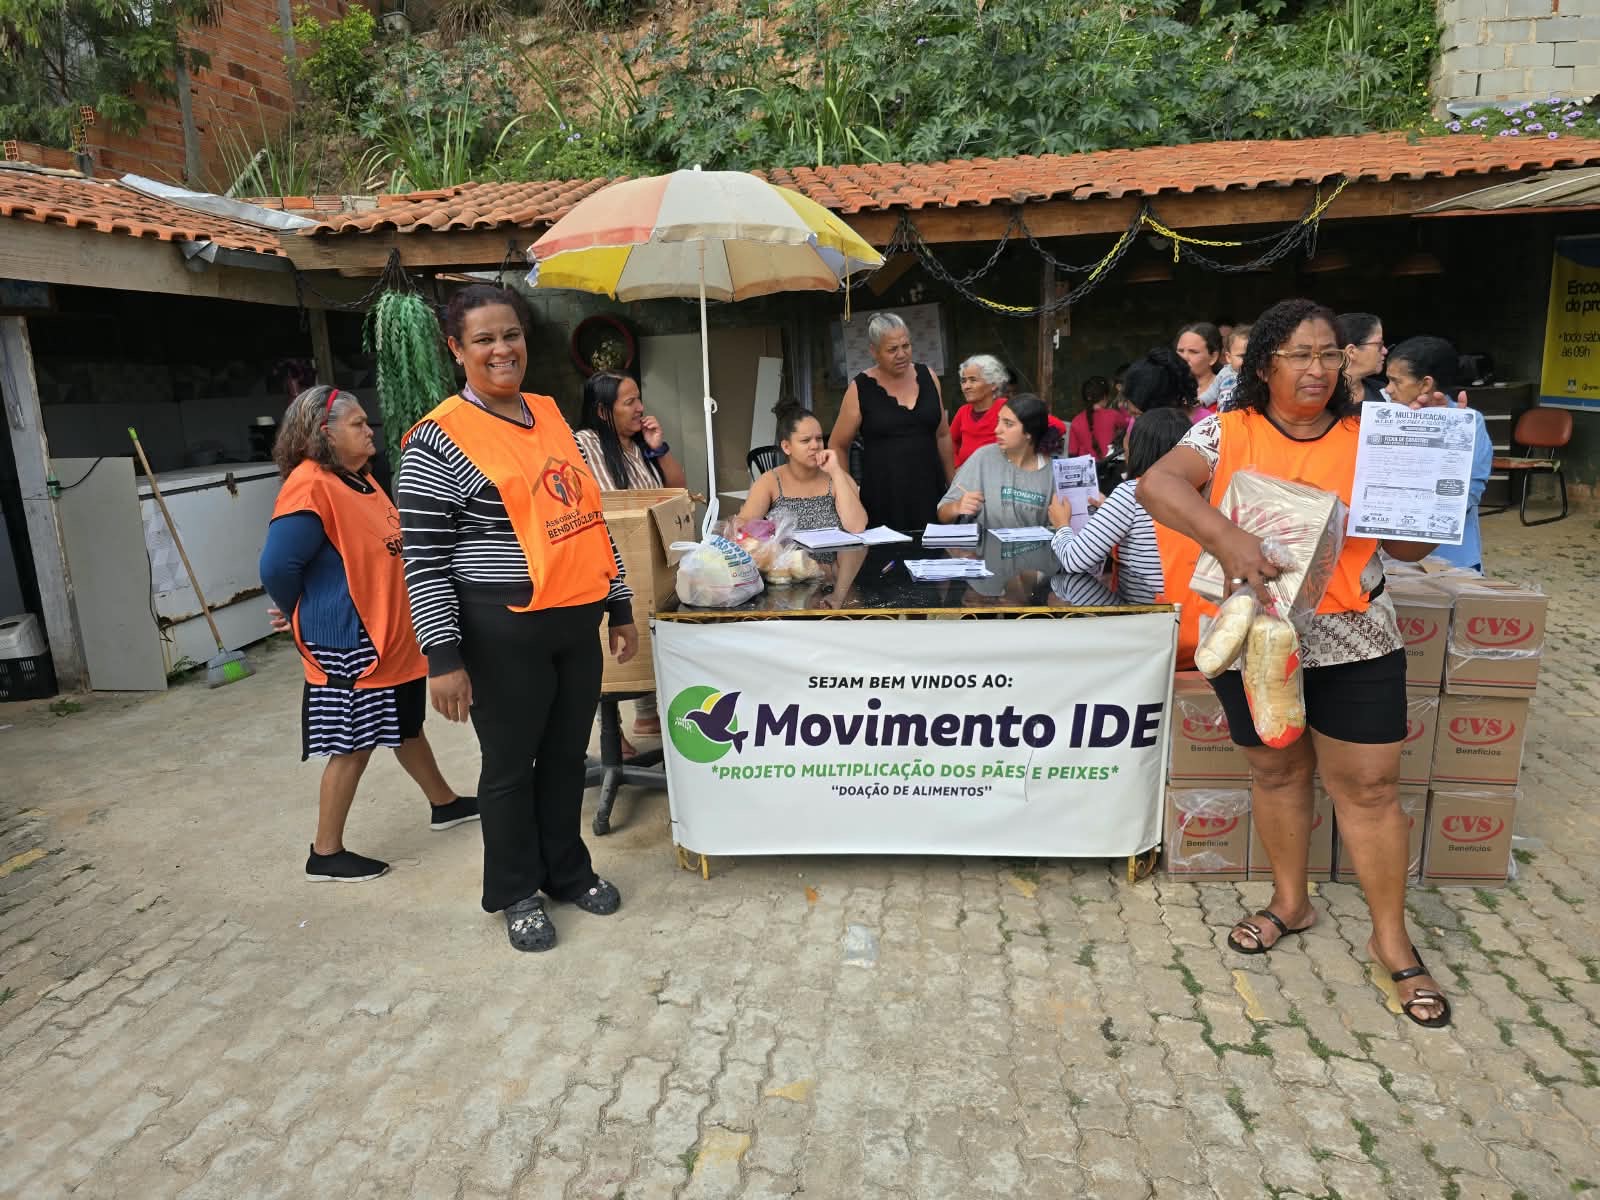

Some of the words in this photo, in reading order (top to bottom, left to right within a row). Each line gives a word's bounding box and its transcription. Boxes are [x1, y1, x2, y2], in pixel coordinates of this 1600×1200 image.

[1396, 616, 1425, 636] VS
[1467, 616, 1521, 637] CVS
[808, 675, 864, 689] SEJAM
[869, 675, 905, 689] BEM
[911, 674, 977, 689] VINDOS
[982, 673, 1013, 689] AO:
[754, 697, 1056, 748] Movimento
[1069, 701, 1164, 749] IDE
[1450, 716, 1503, 736] CVS
[801, 759, 935, 780] MULTIPLICAÇÃO
[940, 764, 976, 778] DOS
[981, 759, 1026, 779] PÃES
[1031, 766, 1042, 780] E
[893, 785, 910, 796] DE
[1441, 815, 1492, 833] CVS
